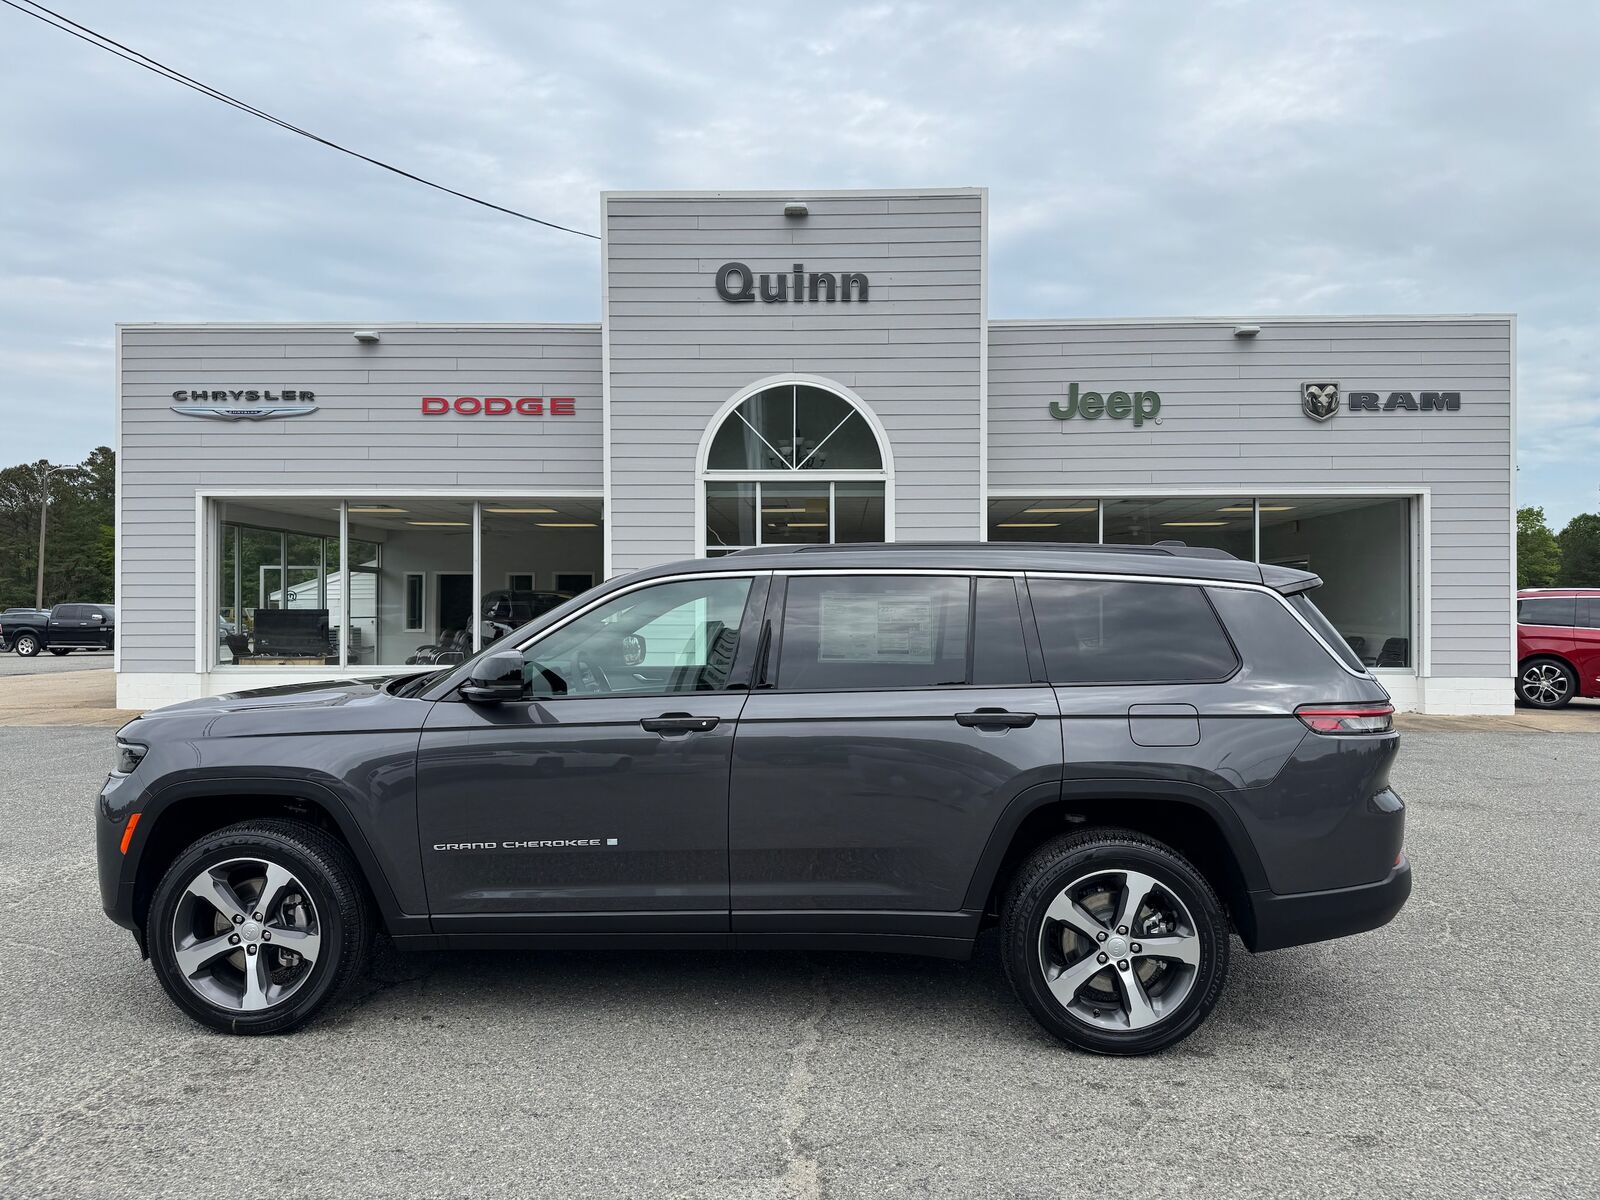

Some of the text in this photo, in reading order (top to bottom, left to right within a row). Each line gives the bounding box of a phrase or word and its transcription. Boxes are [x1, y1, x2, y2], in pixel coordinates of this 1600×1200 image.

[715, 262, 869, 302] Quinn
[172, 390, 316, 401] CHRYSLER
[1049, 383, 1161, 427] Jeep
[1349, 392, 1461, 411] RAM
[421, 397, 577, 416] DODGE
[433, 839, 601, 851] GRAND CHEROKEE
